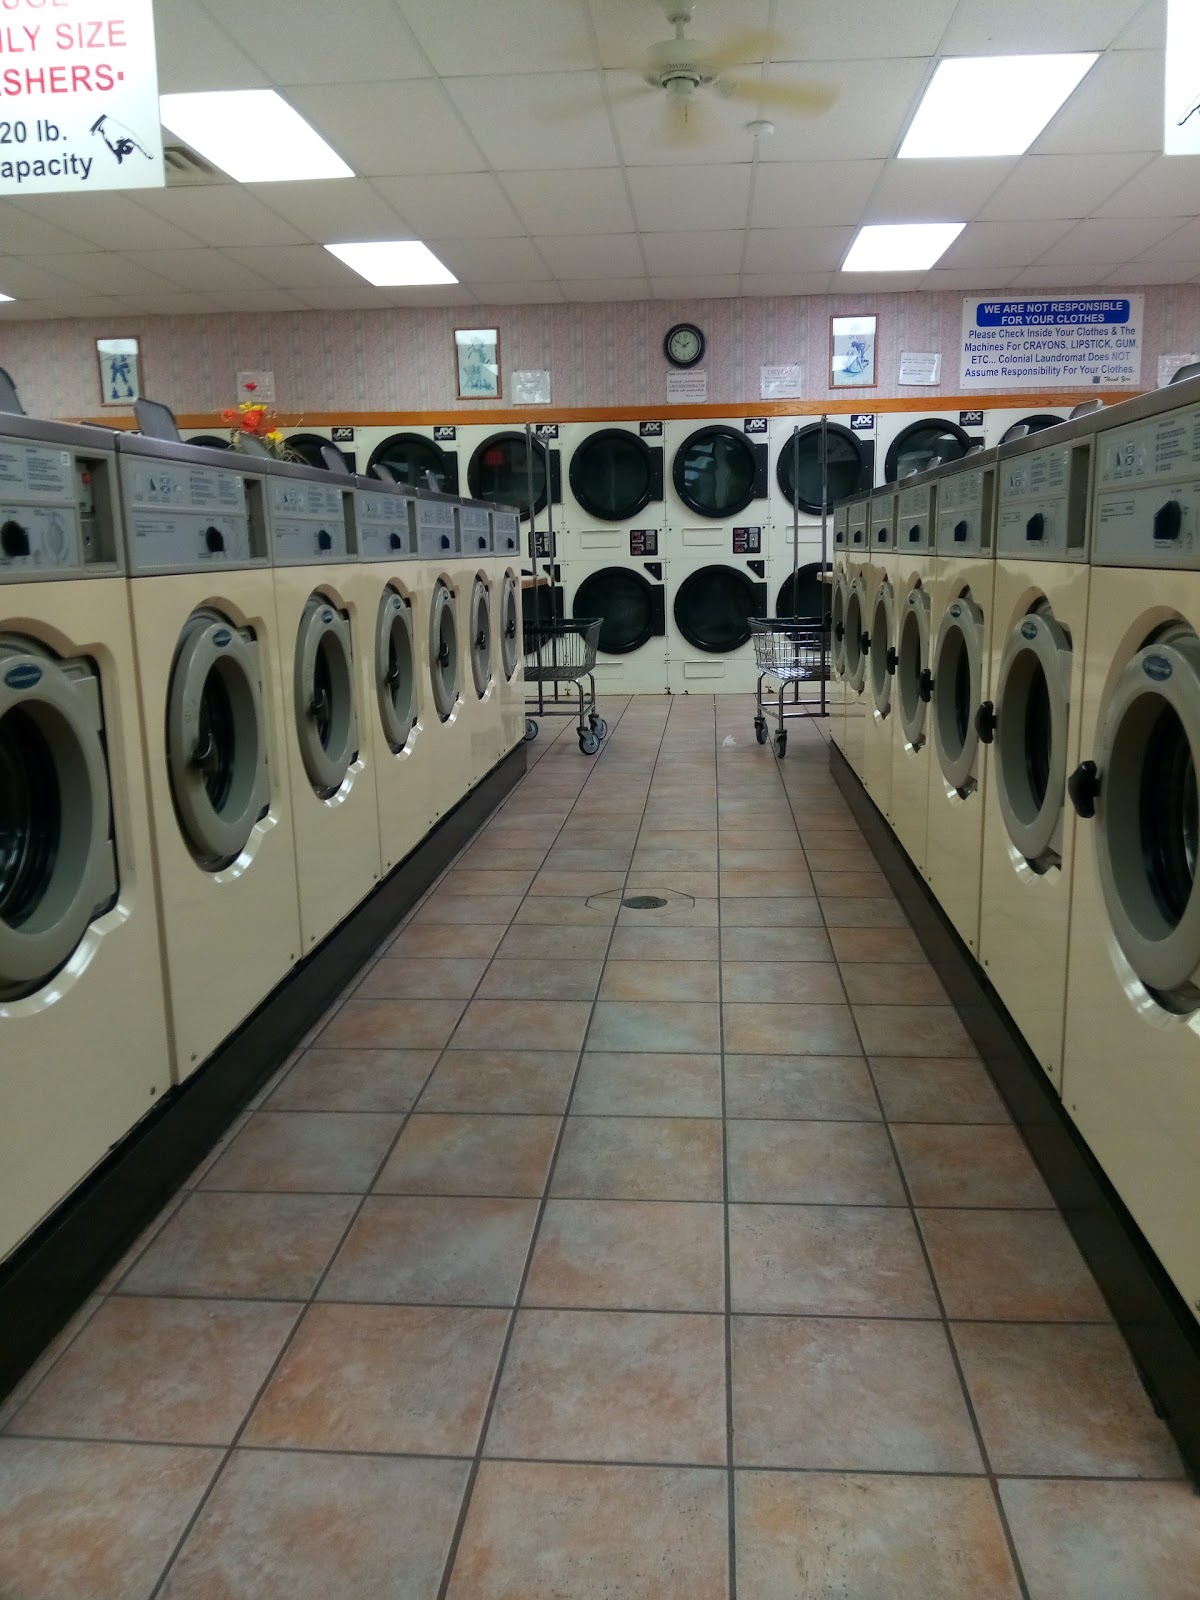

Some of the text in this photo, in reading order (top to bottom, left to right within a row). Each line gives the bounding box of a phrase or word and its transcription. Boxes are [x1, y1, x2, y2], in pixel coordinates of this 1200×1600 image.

[55, 20, 127, 50] SIZE
[0, 119, 67, 144] 20 lb.
[1, 153, 93, 182] apacity
[984, 302, 1123, 314] WE ARE NOT RESPONSIBLE
[1001, 313, 1105, 325] FOR YOUR CLOTHES
[969, 326, 1136, 339] Please Check Inside Your Clothes & The
[964, 342, 1004, 352] Machines
[1006, 342, 1021, 351] For
[1023, 340, 1069, 350] CRAYONS,
[1071, 339, 1113, 349] LIPSTICK,
[971, 351, 1131, 364] ETC... Colonial Laundromat Does NOT
[964, 364, 1136, 377] Assume Responsibility For Your Clothes.
